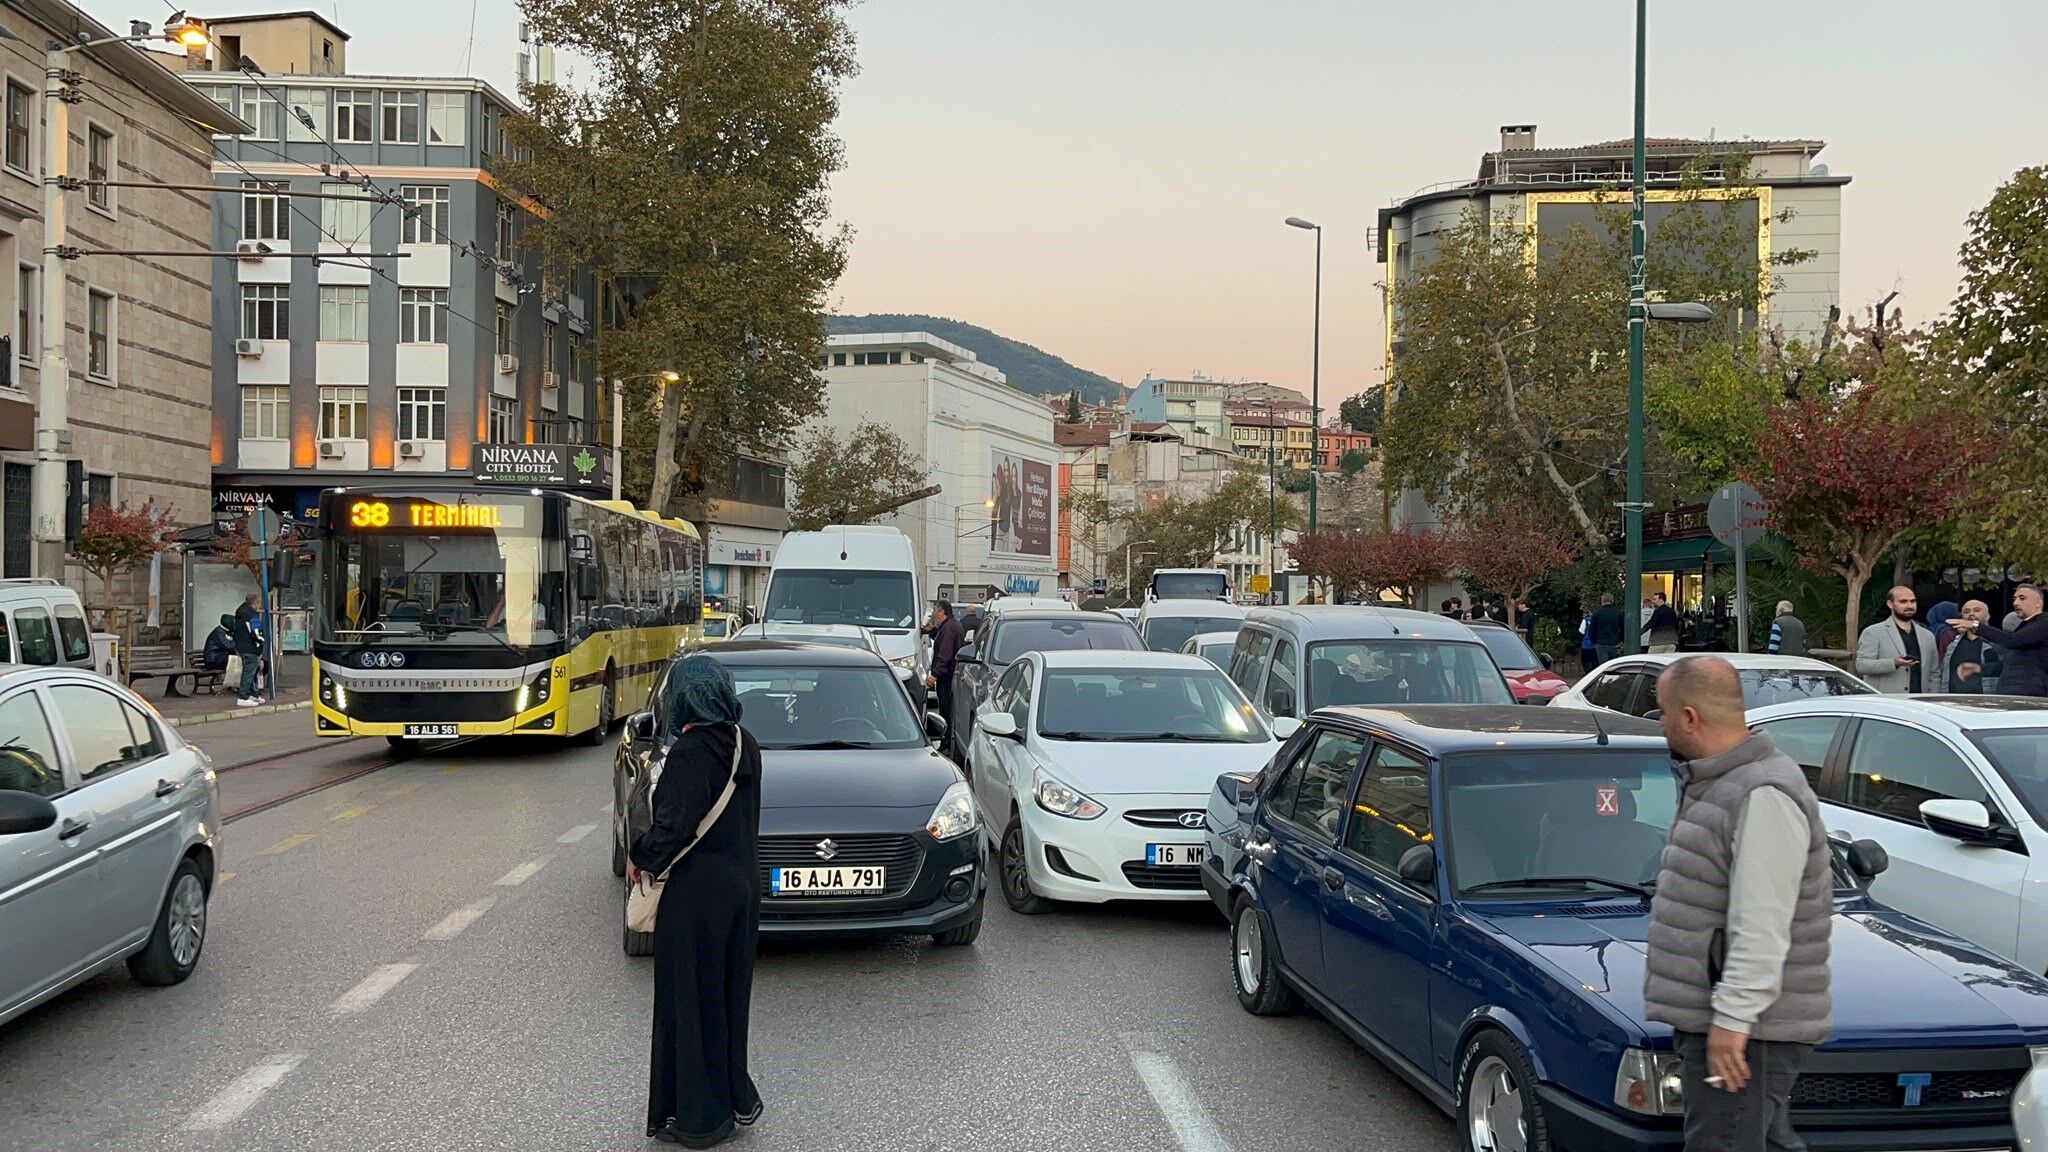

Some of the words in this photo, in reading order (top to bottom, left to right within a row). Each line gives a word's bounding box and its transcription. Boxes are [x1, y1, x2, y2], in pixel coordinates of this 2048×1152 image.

[482, 446, 559, 464] NİRVANA
[486, 463, 512, 473] CITY
[515, 464, 554, 473] HOTEL
[352, 502, 389, 527] 38
[554, 666, 566, 679] 561
[344, 678, 420, 689] BÜYÜKŞEHİR
[442, 678, 516, 689] BELEDİYESİ
[409, 725, 419, 735] 16
[421, 725, 439, 735] ALB
[441, 725, 458, 734] 561
[1158, 847, 1174, 863] 16
[1186, 847, 1204, 863] NM
[783, 870, 802, 888] 16
[808, 869, 844, 888] AJA
[852, 869, 882, 887] 791
